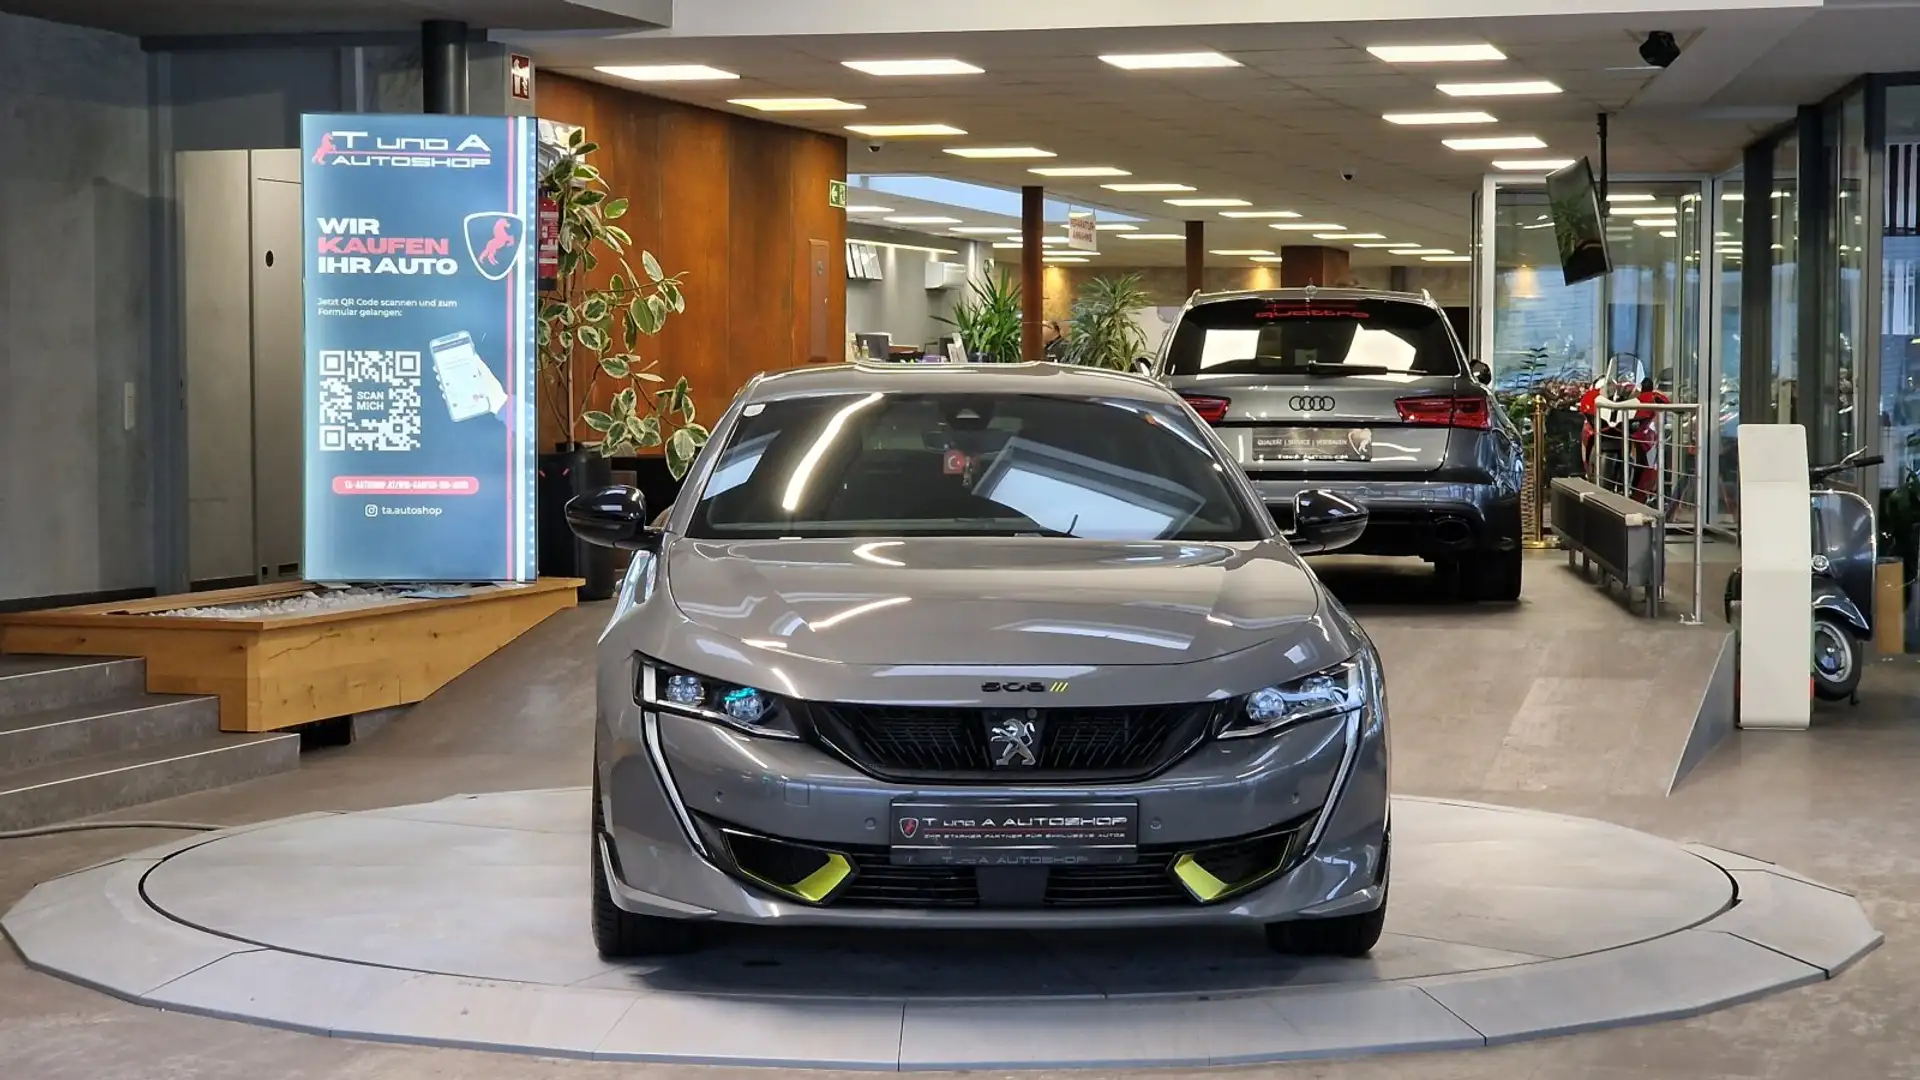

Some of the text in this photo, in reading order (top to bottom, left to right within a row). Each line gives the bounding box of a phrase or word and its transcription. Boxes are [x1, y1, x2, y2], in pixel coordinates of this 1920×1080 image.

[332, 131, 368, 149] T
[456, 134, 491, 151] A
[332, 156, 491, 168] AUTOSHOP
[317, 217, 380, 235] WIR
[318, 237, 449, 256] KAUFEN
[318, 257, 459, 276] IHR AUTO
[318, 297, 458, 308] Jetzt QR Code scannen und zum
[318, 307, 358, 317] Formular
[1255, 309, 1370, 319] quattro
[356, 391, 384, 401] SCAN
[356, 401, 384, 411] MICH
[381, 506, 442, 516] ta.autoshop
[922, 817, 938, 826] T
[981, 818, 996, 827] A
[1002, 817, 1128, 826] AUTOSHOP
[996, 855, 1089, 864] AUTOSHOP
